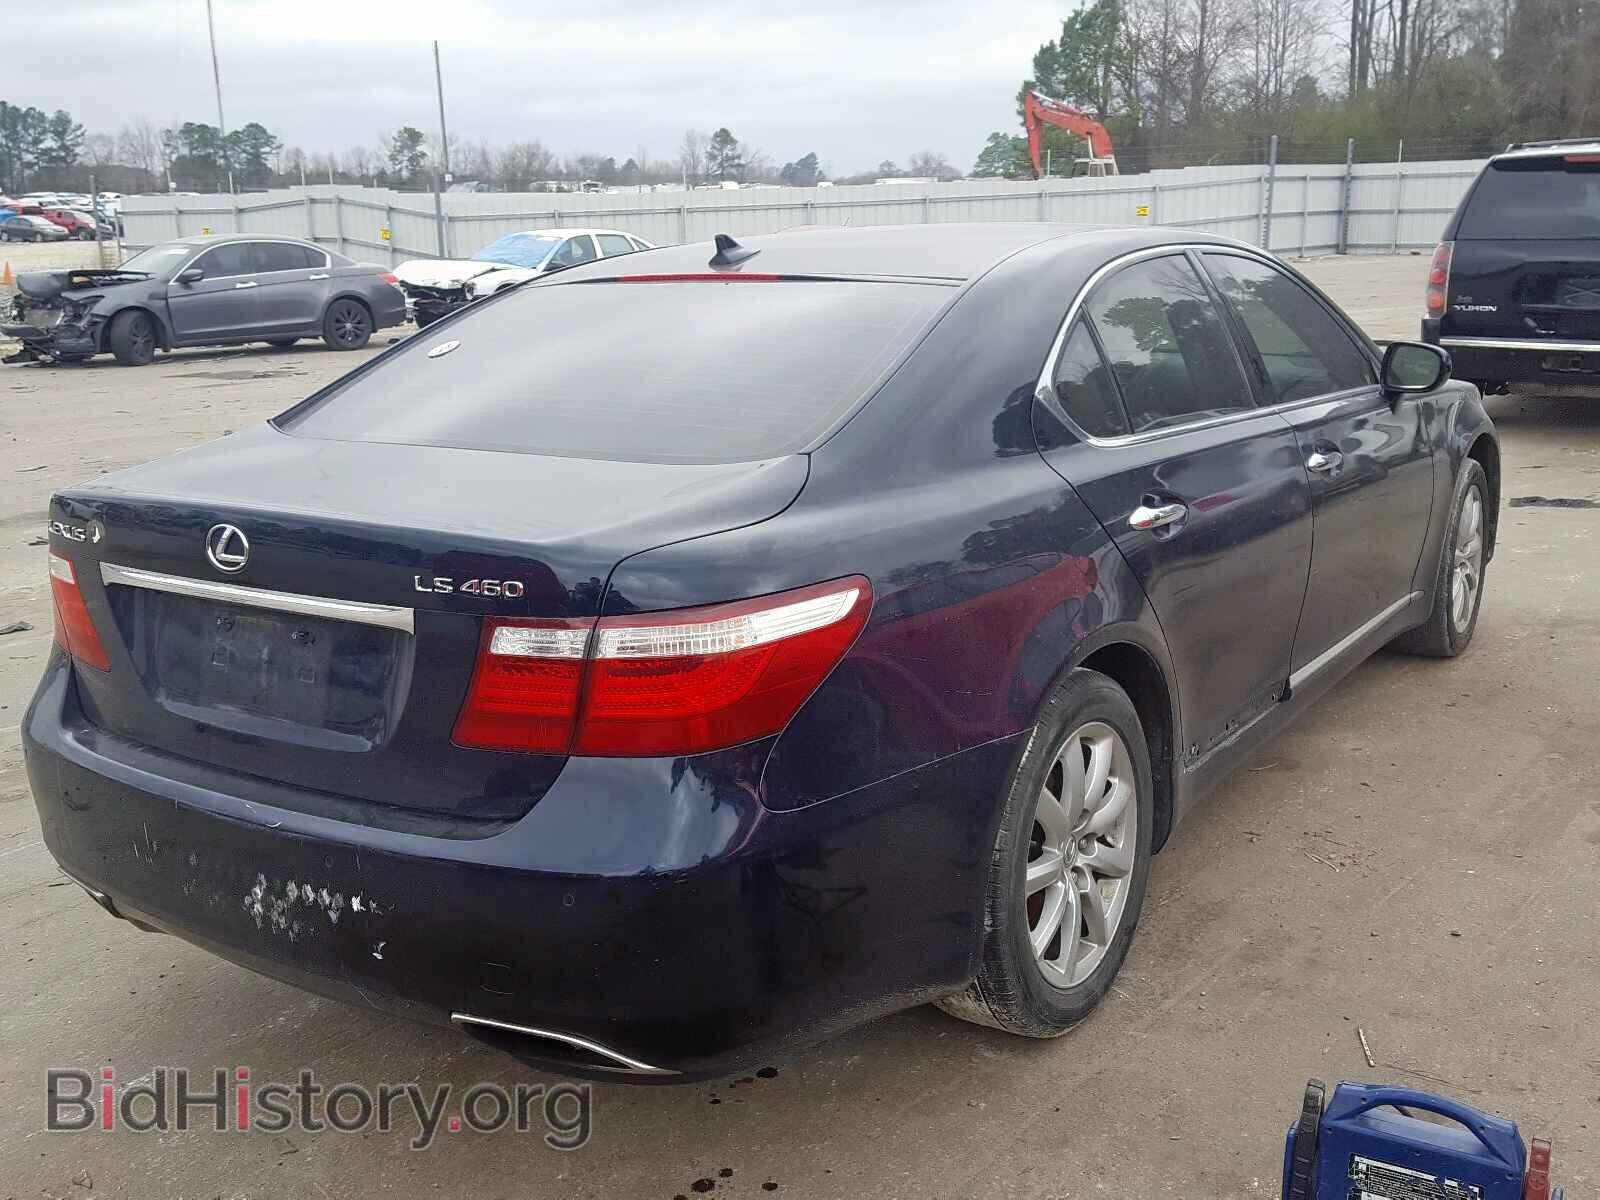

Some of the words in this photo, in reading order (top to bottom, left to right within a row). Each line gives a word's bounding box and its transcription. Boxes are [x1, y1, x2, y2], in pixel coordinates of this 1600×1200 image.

[1453, 304, 1498, 313] YUKON
[414, 575, 454, 594] LS
[459, 578, 524, 598] 460
